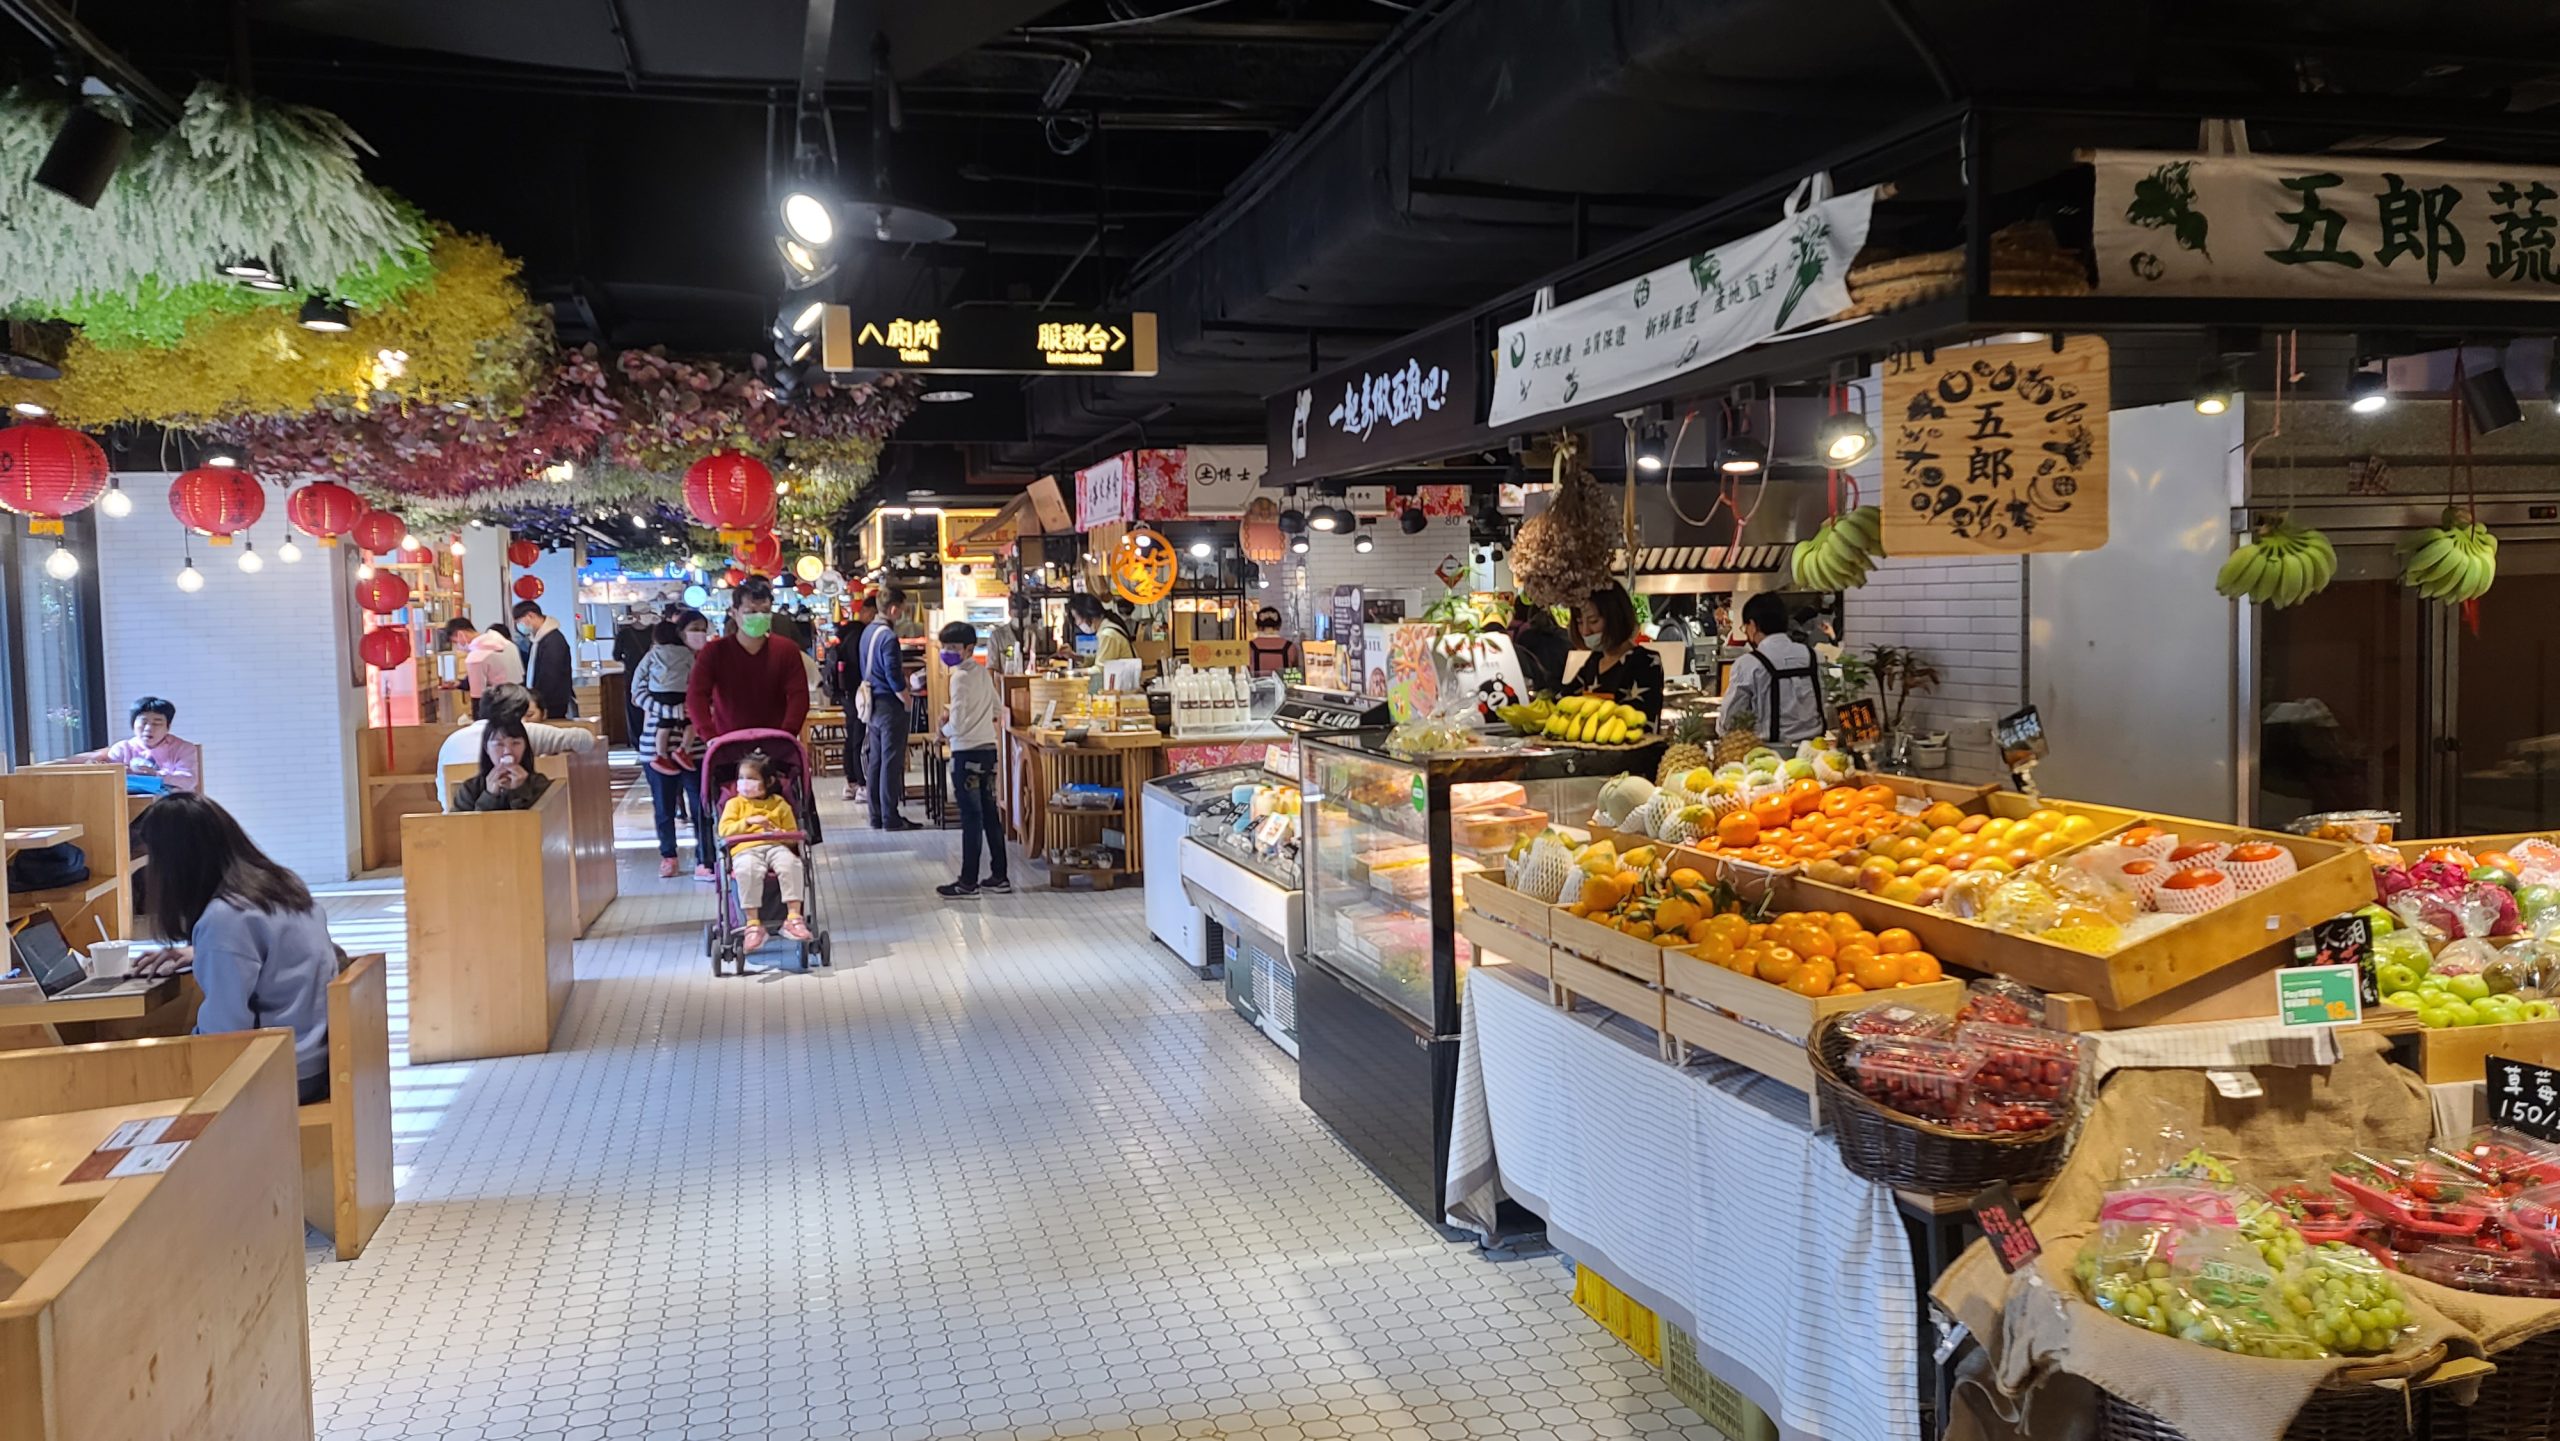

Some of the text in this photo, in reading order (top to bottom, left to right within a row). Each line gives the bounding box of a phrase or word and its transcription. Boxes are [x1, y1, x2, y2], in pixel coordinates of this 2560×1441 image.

[2264, 171, 2560, 285] 五郎蔬
[1531, 343, 1573, 371] 天然健康
[1582, 324, 1628, 356] 品質保證
[1712, 262, 1779, 315] 產地直送
[886, 317, 942, 350] 廁所
[1036, 322, 1111, 352] 服務台
[898, 348, 930, 363] Toilet
[1966, 401, 2016, 488] 五郎
[1444, 516, 1460, 526] 80
[2503, 1066, 2558, 1106] 草莓
[2500, 1099, 2560, 1130] 150/
